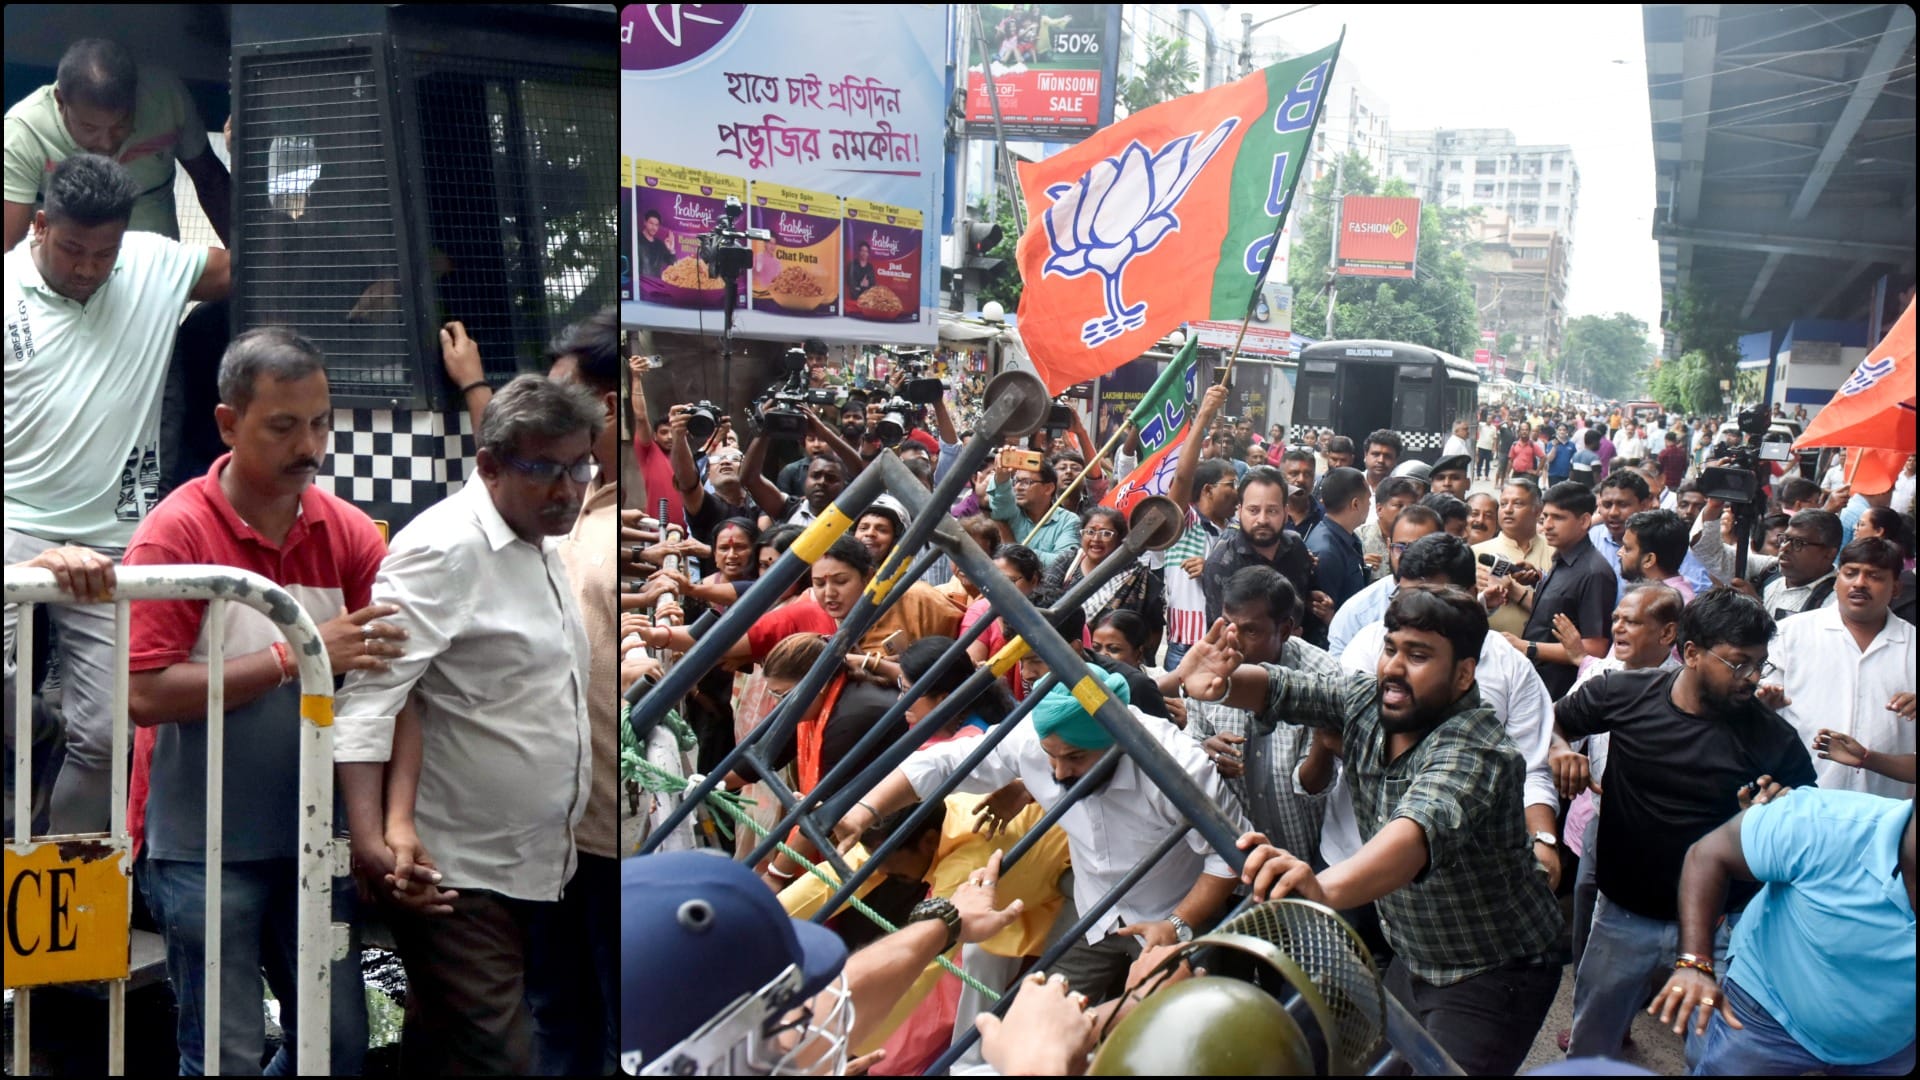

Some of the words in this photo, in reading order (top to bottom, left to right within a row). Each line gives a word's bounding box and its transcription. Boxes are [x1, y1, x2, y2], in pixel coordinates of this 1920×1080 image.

[1057, 34, 1099, 53] 50%
[1041, 77, 1094, 93] MONSOON
[723, 72, 778, 104] হাতে
[785, 73, 823, 110] চাই
[828, 74, 901, 118] প্রতিদিন
[1049, 96, 1083, 112] SALE
[716, 114, 821, 169] প্রভুজির
[829, 120, 920, 162] নমকীন!
[1349, 222, 1389, 233] FASHION
[776, 249, 797, 261] Chat
[799, 252, 818, 264] Pata
